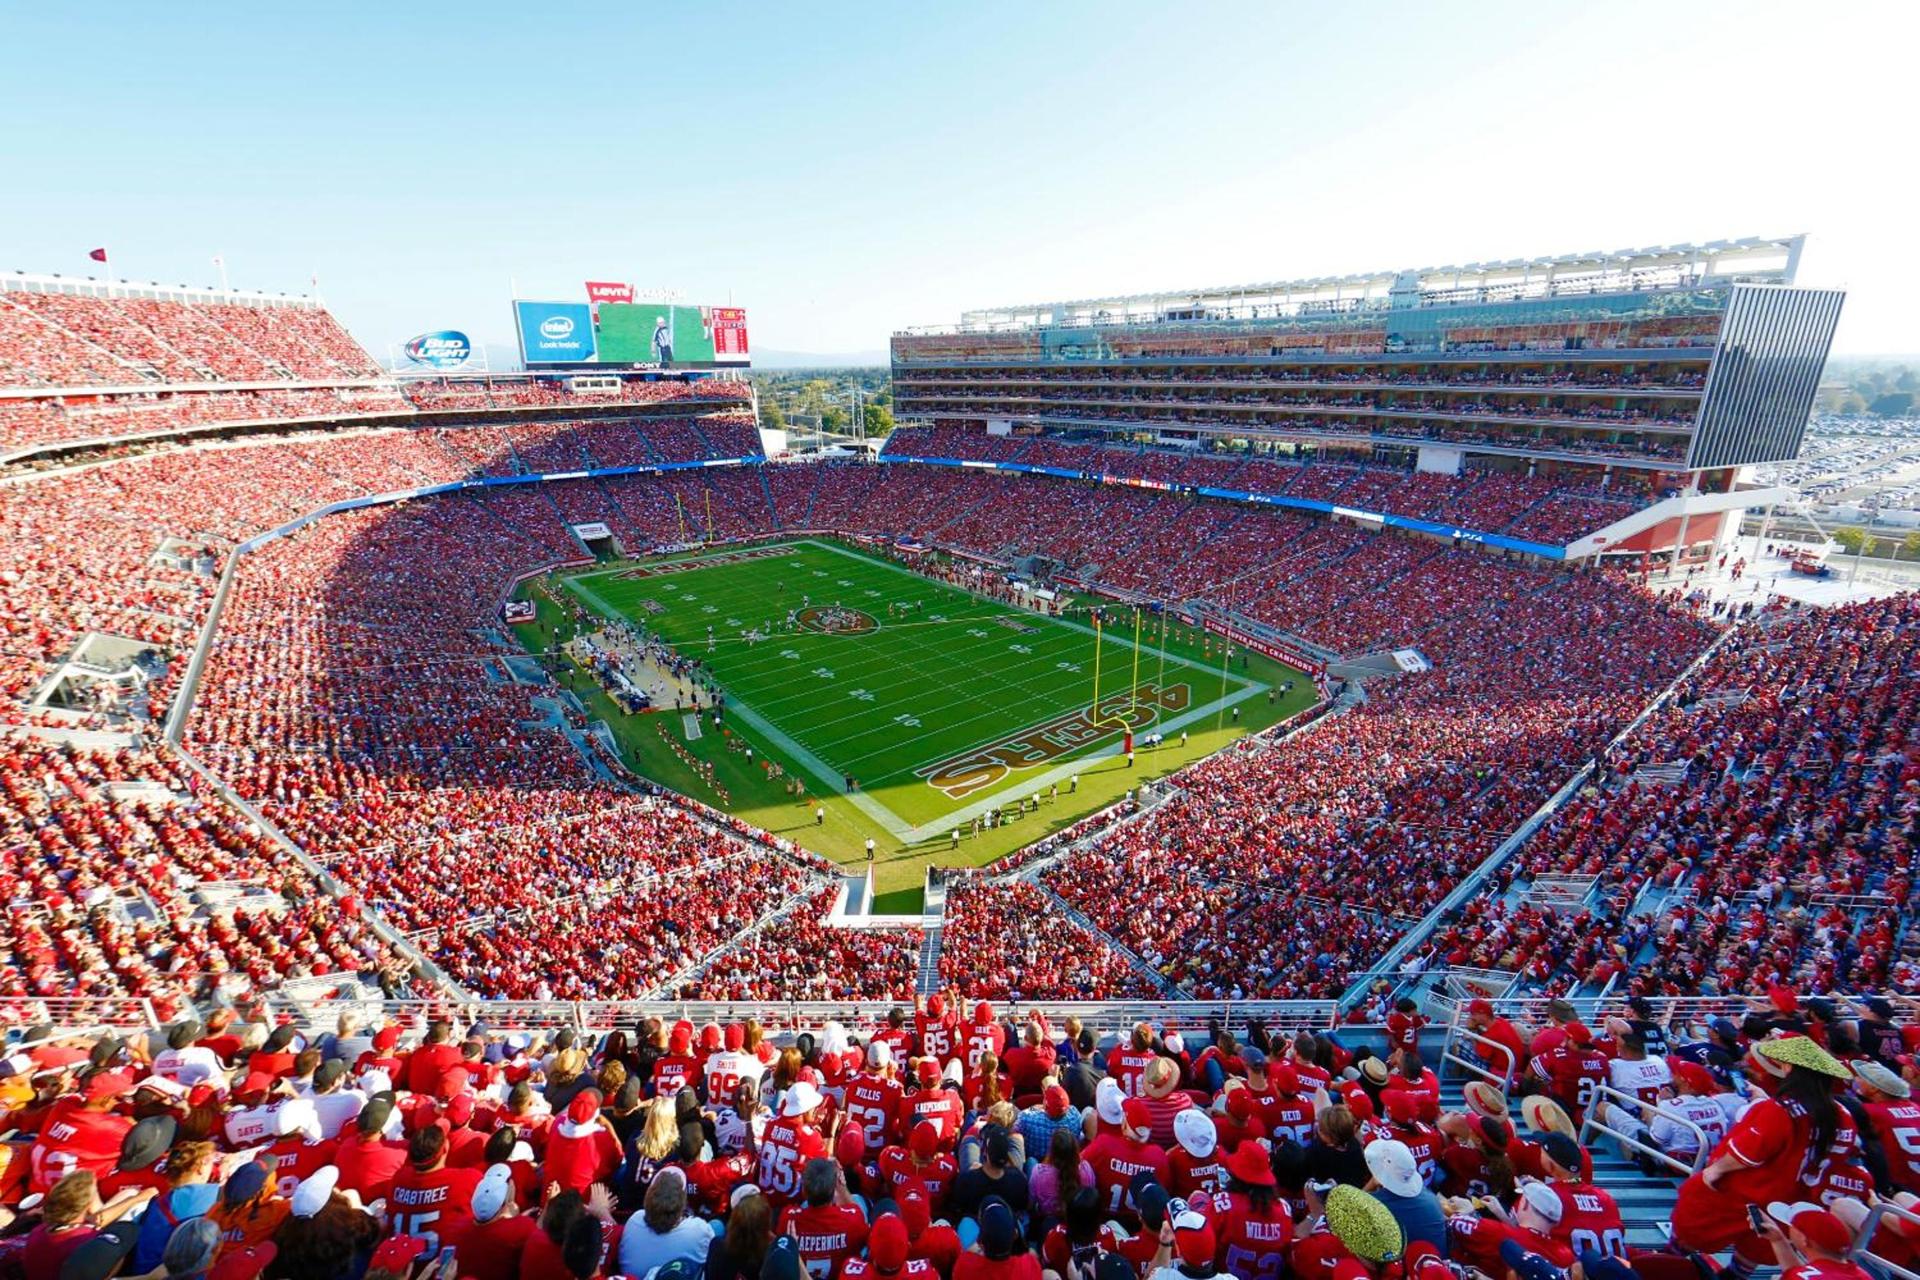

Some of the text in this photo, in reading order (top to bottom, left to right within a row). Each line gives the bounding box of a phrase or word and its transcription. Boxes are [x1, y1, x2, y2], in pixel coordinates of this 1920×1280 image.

[1249, 639, 1268, 652] BOWL
[1269, 647, 1313, 672] CHAMPIONS
[911, 682, 1192, 800] 49ERS
[923, 1030, 950, 1056] 85
[662, 1065, 684, 1074] WILLIS
[657, 1075, 687, 1098] 52
[855, 1086, 882, 1101] WILLIS
[48, 1122, 78, 1141] LOTT
[771, 1125, 795, 1144] DAVIS
[758, 1140, 799, 1194] 85
[1830, 1174, 1864, 1192] WILLIS
[393, 1186, 450, 1205] CRABTREE
[1572, 1194, 1604, 1212] RICE
[392, 1210, 441, 1261] 15
[1245, 1221, 1282, 1241] WILLIS
[798, 1233, 848, 1251] AEPERNICK
[1226, 1243, 1283, 1280] 52
